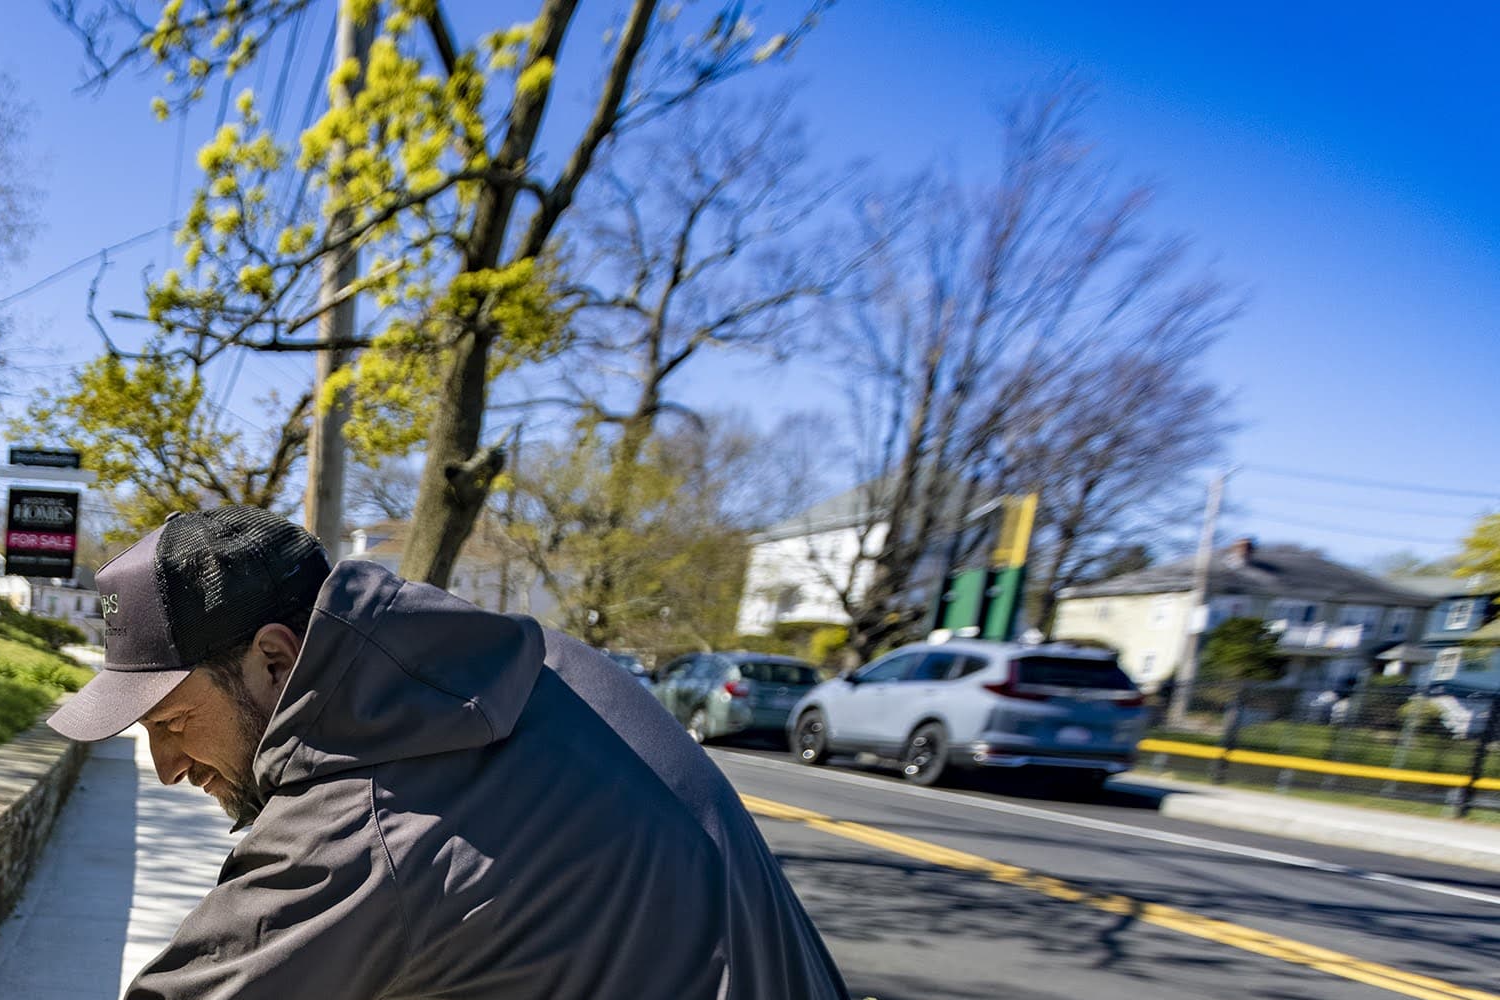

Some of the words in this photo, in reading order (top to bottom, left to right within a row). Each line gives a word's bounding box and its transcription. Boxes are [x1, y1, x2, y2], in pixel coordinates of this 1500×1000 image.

[13, 504, 73, 521] HOMES
[9, 533, 37, 546] FOR
[41, 535, 72, 547] SALE
